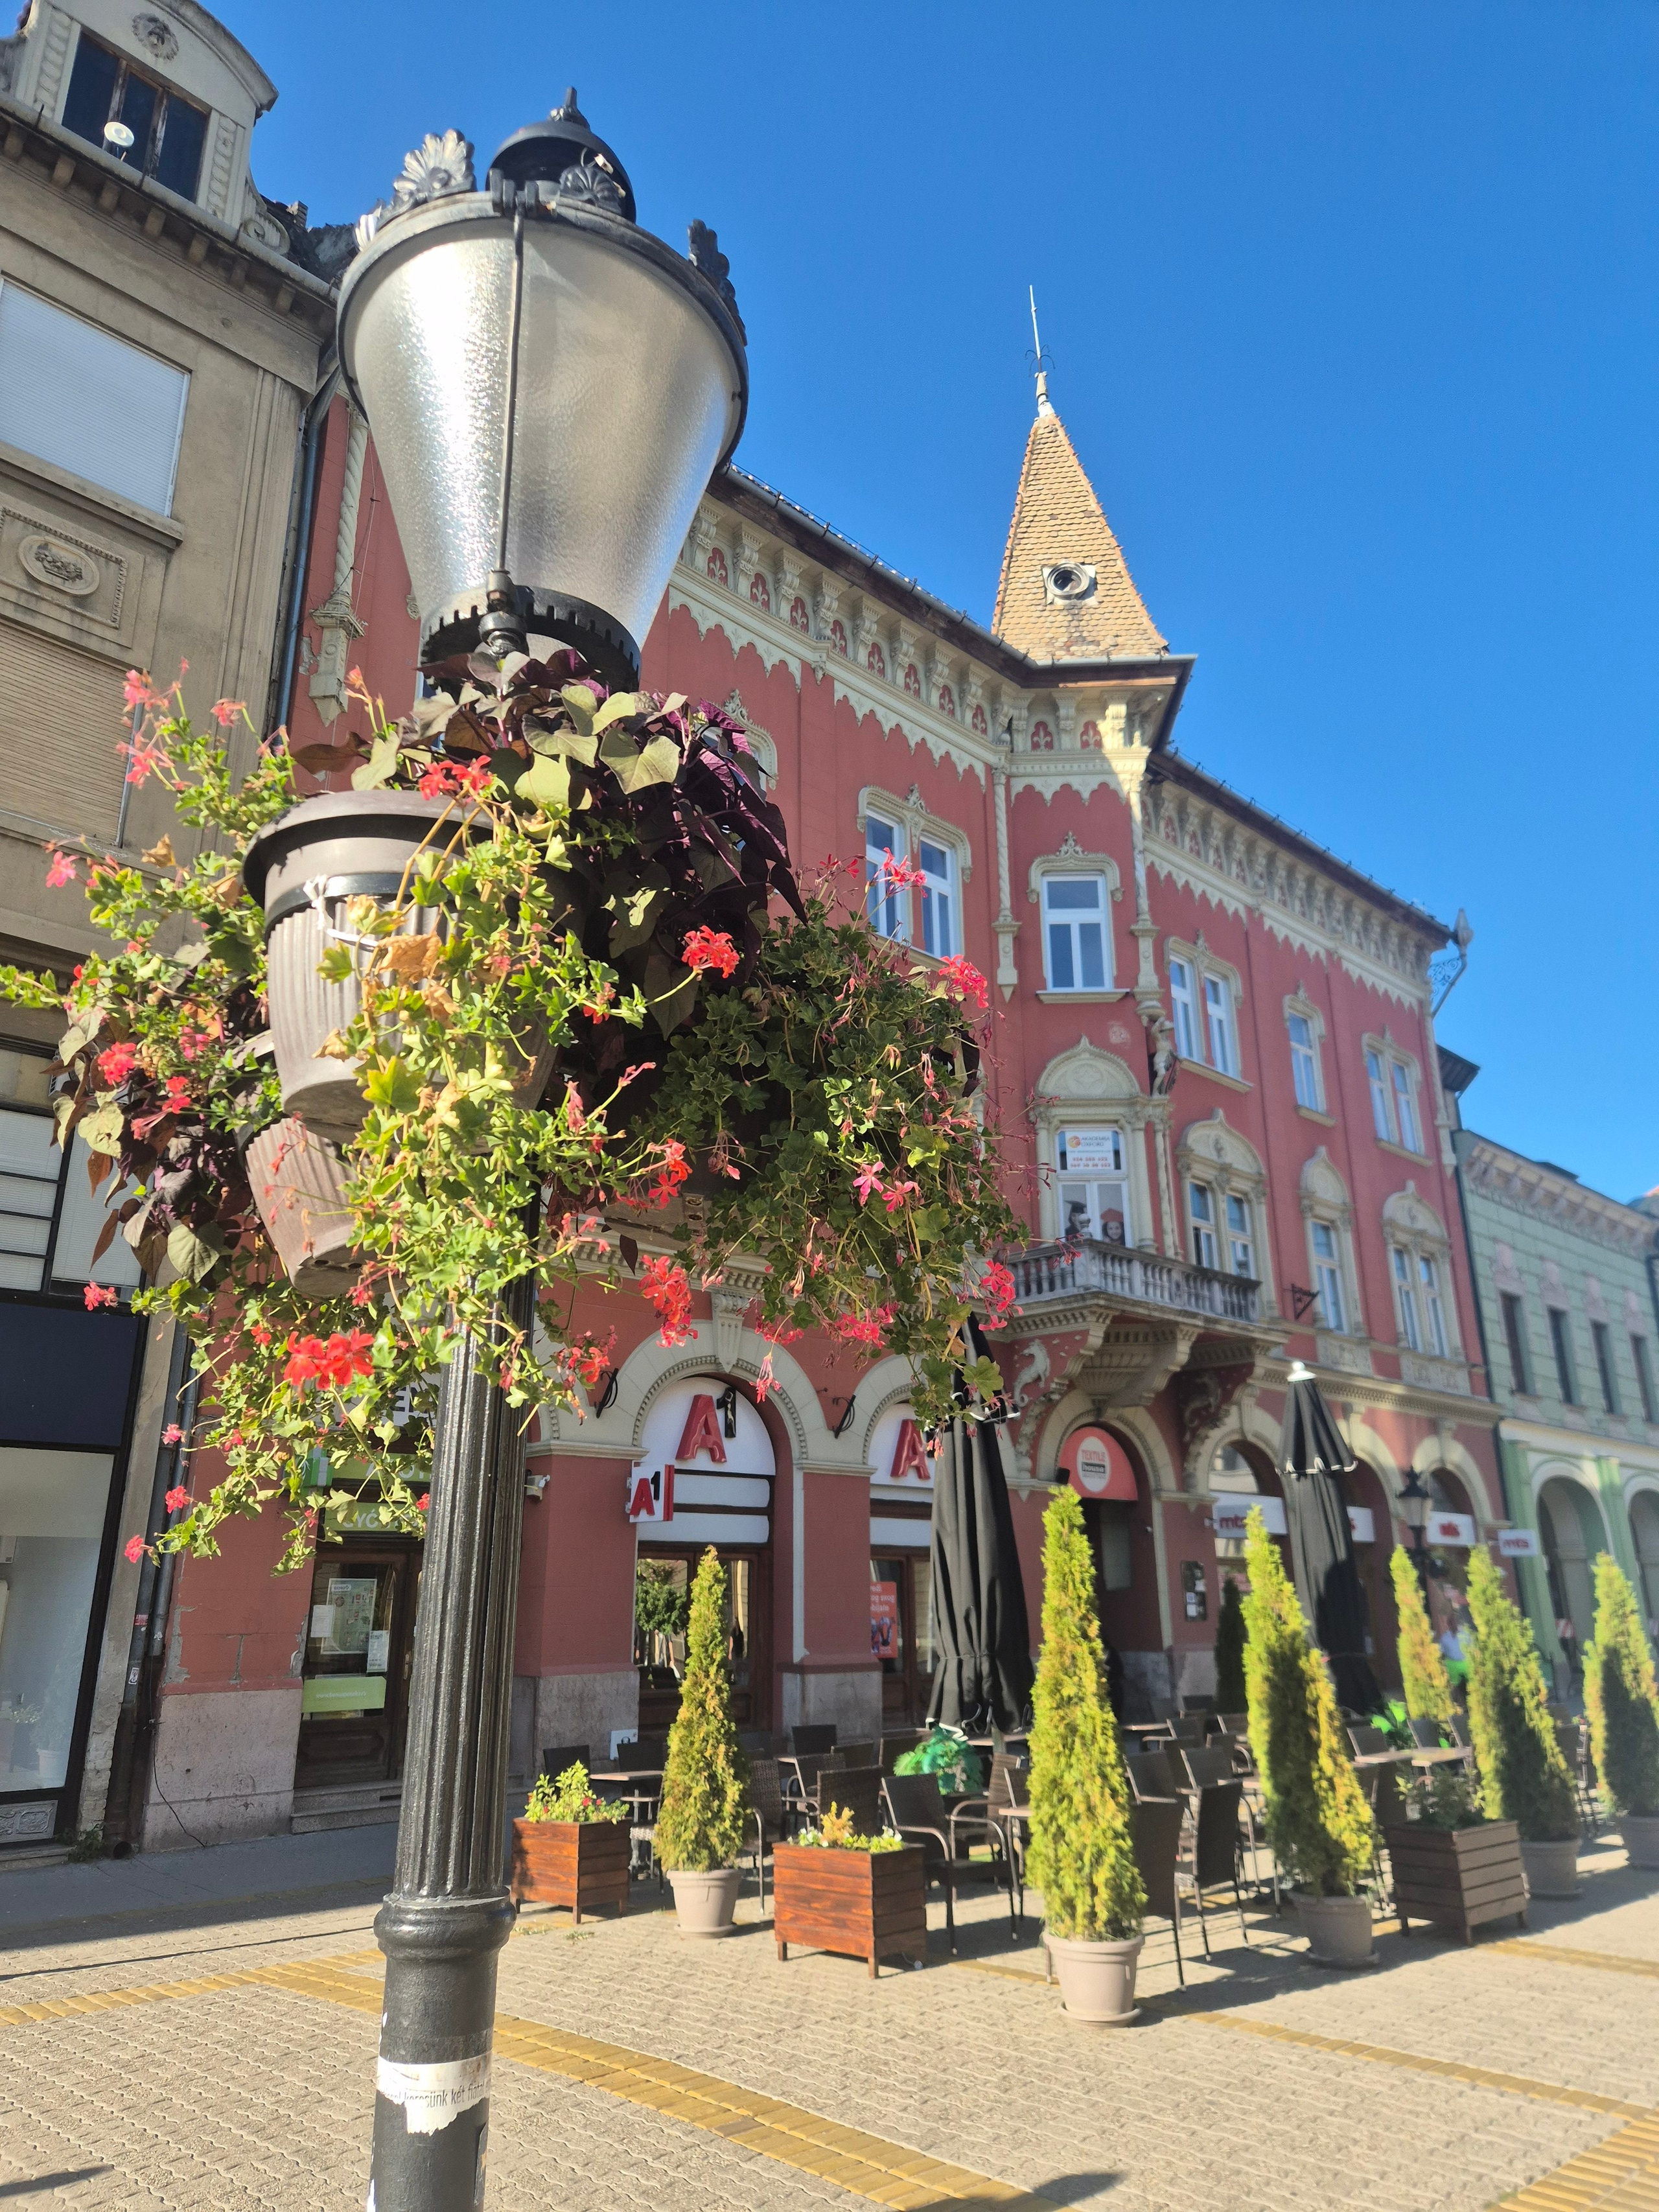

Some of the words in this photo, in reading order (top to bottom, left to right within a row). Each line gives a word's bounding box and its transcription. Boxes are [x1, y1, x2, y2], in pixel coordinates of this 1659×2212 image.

[675, 1386, 736, 1463] A1
[1082, 1449, 1106, 1463] TEXTILE
[1082, 1463, 1105, 1472] house
[629, 1471, 660, 1516] A1
[1503, 1538, 1529, 1548] mts
[450, 2085, 465, 2105] két
[467, 2081, 485, 2102] fiatal
